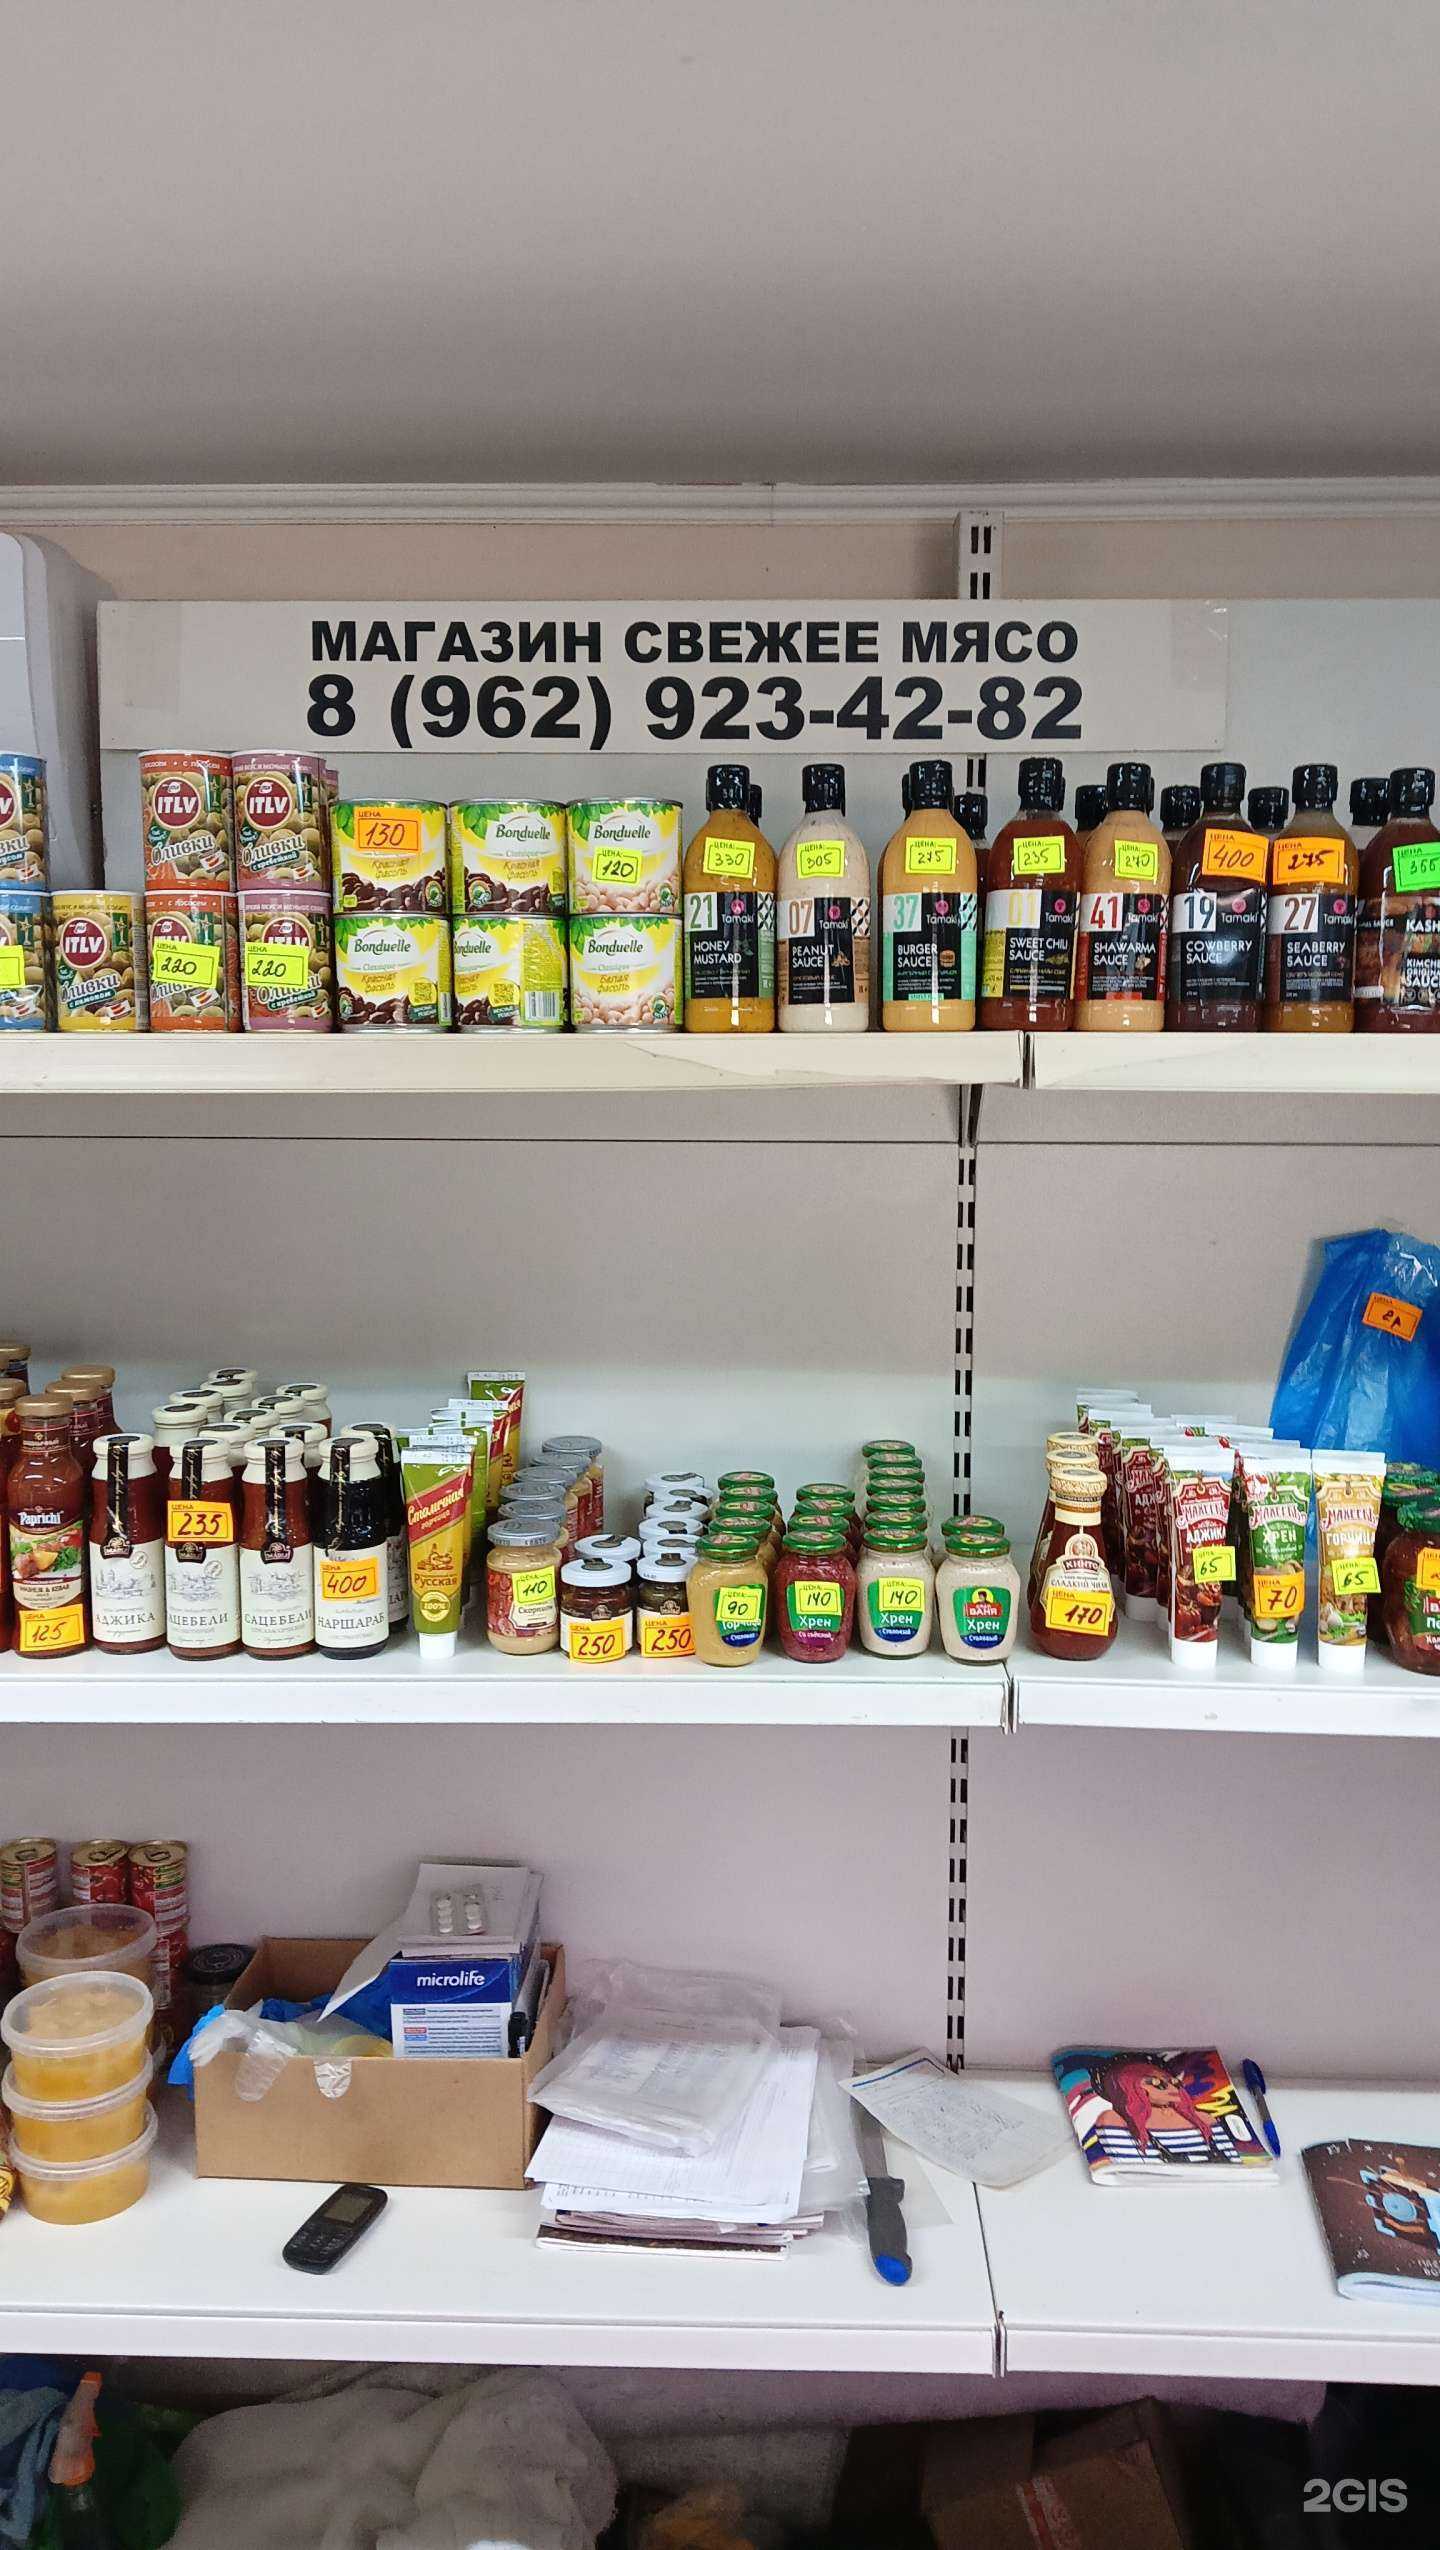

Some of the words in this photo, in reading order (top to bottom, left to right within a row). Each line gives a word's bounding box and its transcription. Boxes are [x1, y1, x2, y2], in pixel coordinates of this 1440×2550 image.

[311, 620, 601, 663] МАГАЗИН
[623, 620, 880, 664] СВЕЖЕЕ
[902, 620, 1079, 664] МЯСО
[306, 673, 357, 738] 8
[390, 674, 612, 750] (962)
[644, 675, 1083, 741] 923-42-82
[157, 797, 197, 815] ITLV
[250, 797, 289, 814] ITLV
[365, 822, 406, 848] 130
[495, 824, 551, 842] Bonduelle
[594, 824, 651, 842] Bonduelle
[714, 853, 745, 867] 330
[806, 853, 833, 869] 305
[1213, 843, 1255, 869] 400
[1287, 849, 1335, 871] 275
[602, 859, 635, 878] 120
[690, 895, 713, 929] 21
[721, 913, 755, 924] Tamaki
[788, 900, 814, 936] 07
[893, 895, 919, 930] 37
[926, 914, 958, 925] Tamaki
[1045, 913, 1074, 924] Tamaki
[1089, 896, 1118, 929] 41
[1184, 895, 1215, 930] 19
[1221, 912, 1259, 923] Tamaki
[1283, 896, 1317, 931] 27
[819, 919, 849, 930] Tamaki
[64, 936, 103, 953] ITLV
[156, 943, 178, 951] ЦЕНА
[247, 945, 268, 953] ЦЕНА
[354, 938, 411, 956] Bonduelle
[588, 938, 644, 956] Bonduelle
[693, 940, 730, 951] HONEY
[792, 945, 835, 956] PEANUT
[897, 944, 938, 955] BURGER
[1009, 938, 1044, 949] SWEET
[1046, 938, 1068, 950] CHILI
[1093, 942, 1156, 953] SHAWARMA
[1186, 940, 1253, 951] COWBERRY
[1286, 941, 1346, 954] SEABERRY
[693, 953, 742, 965] MUSTARD
[792, 957, 824, 969] SAUCE
[897, 956, 932, 968] SAUCE
[1009, 950, 1045, 961] SAUCE
[1093, 954, 1129, 966] SAUCE
[1186, 953, 1223, 965] SAUCE
[1286, 954, 1328, 967] SAUCE
[161, 956, 198, 976] 220
[251, 959, 288, 978] 220
[171, 1503, 194, 1511] ЦЕНА
[407, 1487, 465, 1526] Столичная
[19, 1510, 61, 1527] Paprichi
[177, 1512, 223, 1536] 235
[1200, 1556, 1223, 1575] 65
[326, 1573, 367, 1594] 400
[414, 1573, 458, 1589] Русская
[1343, 1571, 1370, 1588] 65
[522, 1580, 548, 1597] 110
[889, 1589, 918, 1605] 140
[807, 1591, 832, 1606] 140
[1267, 1586, 1298, 1610] 70
[727, 1600, 749, 1616] 90
[969, 1607, 998, 1616] ВАНЯ
[1064, 1604, 1103, 1625] 170
[799, 1616, 832, 1629] Хрен
[881, 1611, 913, 1627] Хрен
[966, 1618, 1000, 1634] Хрен
[577, 1634, 616, 1657] 250
[651, 1628, 692, 1652] 250
[416, 1970, 486, 1988] microlife
